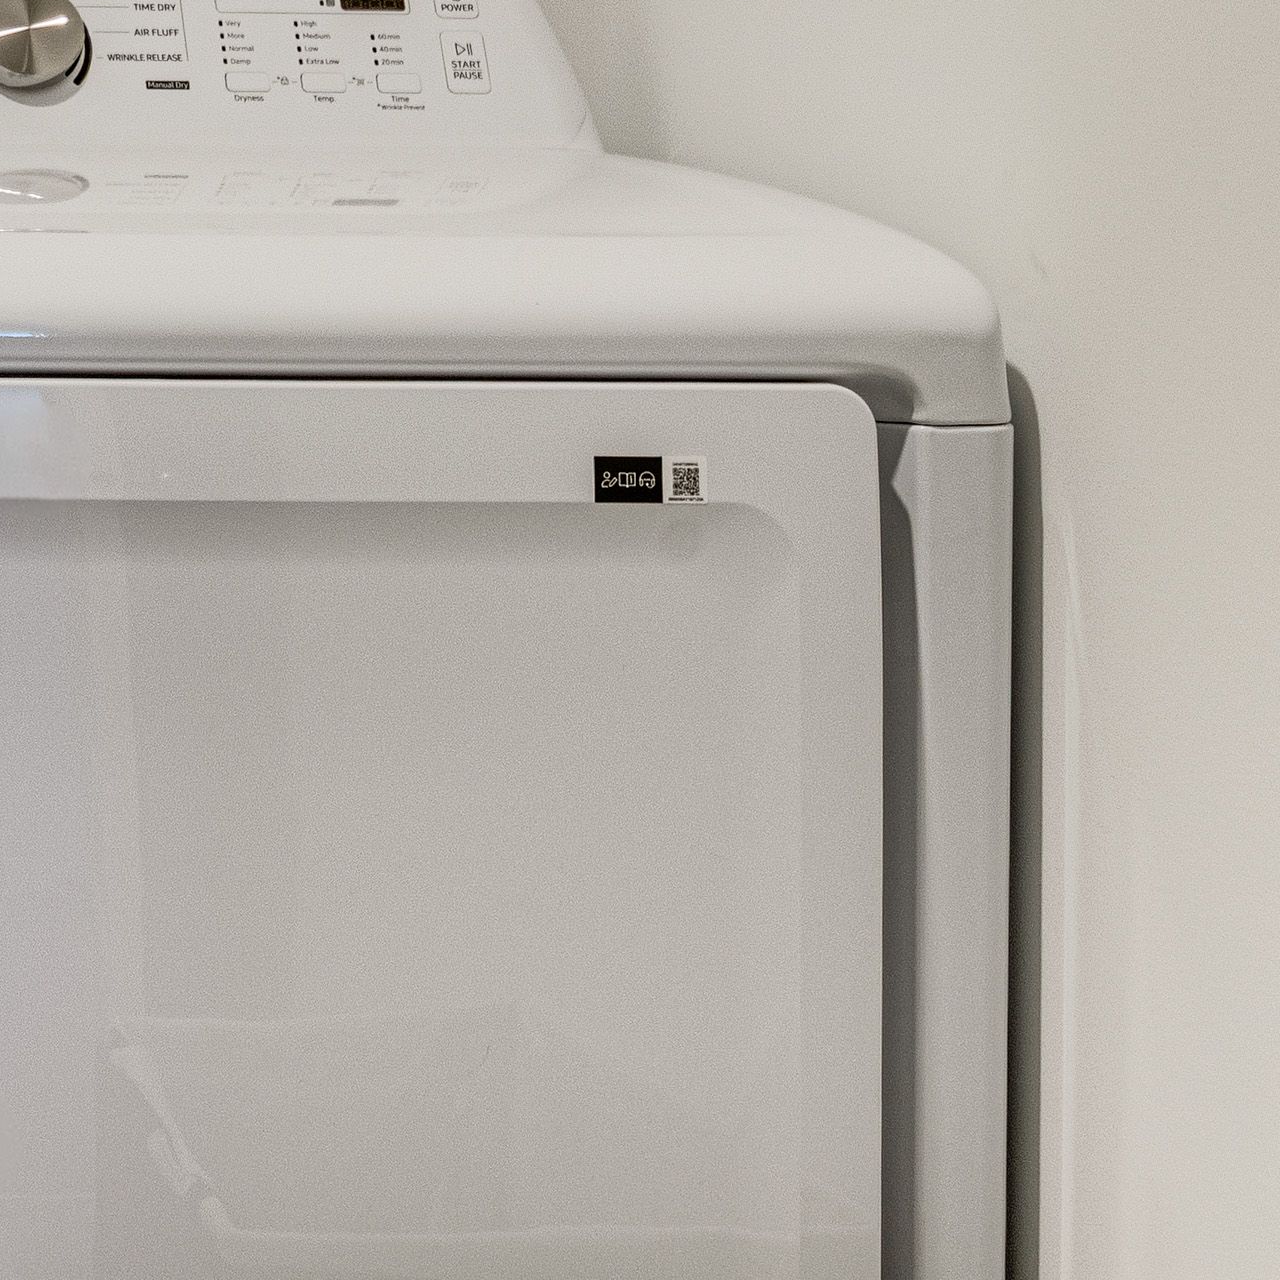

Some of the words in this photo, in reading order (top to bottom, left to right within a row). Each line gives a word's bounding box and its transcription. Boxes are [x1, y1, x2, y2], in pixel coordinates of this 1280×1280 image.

[134, 3, 155, 12] TIME
[156, 3, 176, 12] DRY
[441, 4, 474, 12] POWER
[134, 28, 149, 37] AIR
[150, 28, 179, 37] FLUFF
[107, 53, 145, 62] WRINKLE
[146, 53, 183, 62] RELEASE
[230, 58, 251, 66] Damp
[451, 61, 481, 69] START
[453, 71, 483, 80] PAUSE
[147, 81, 175, 89] Manual
[175, 81, 188, 89] Dry
